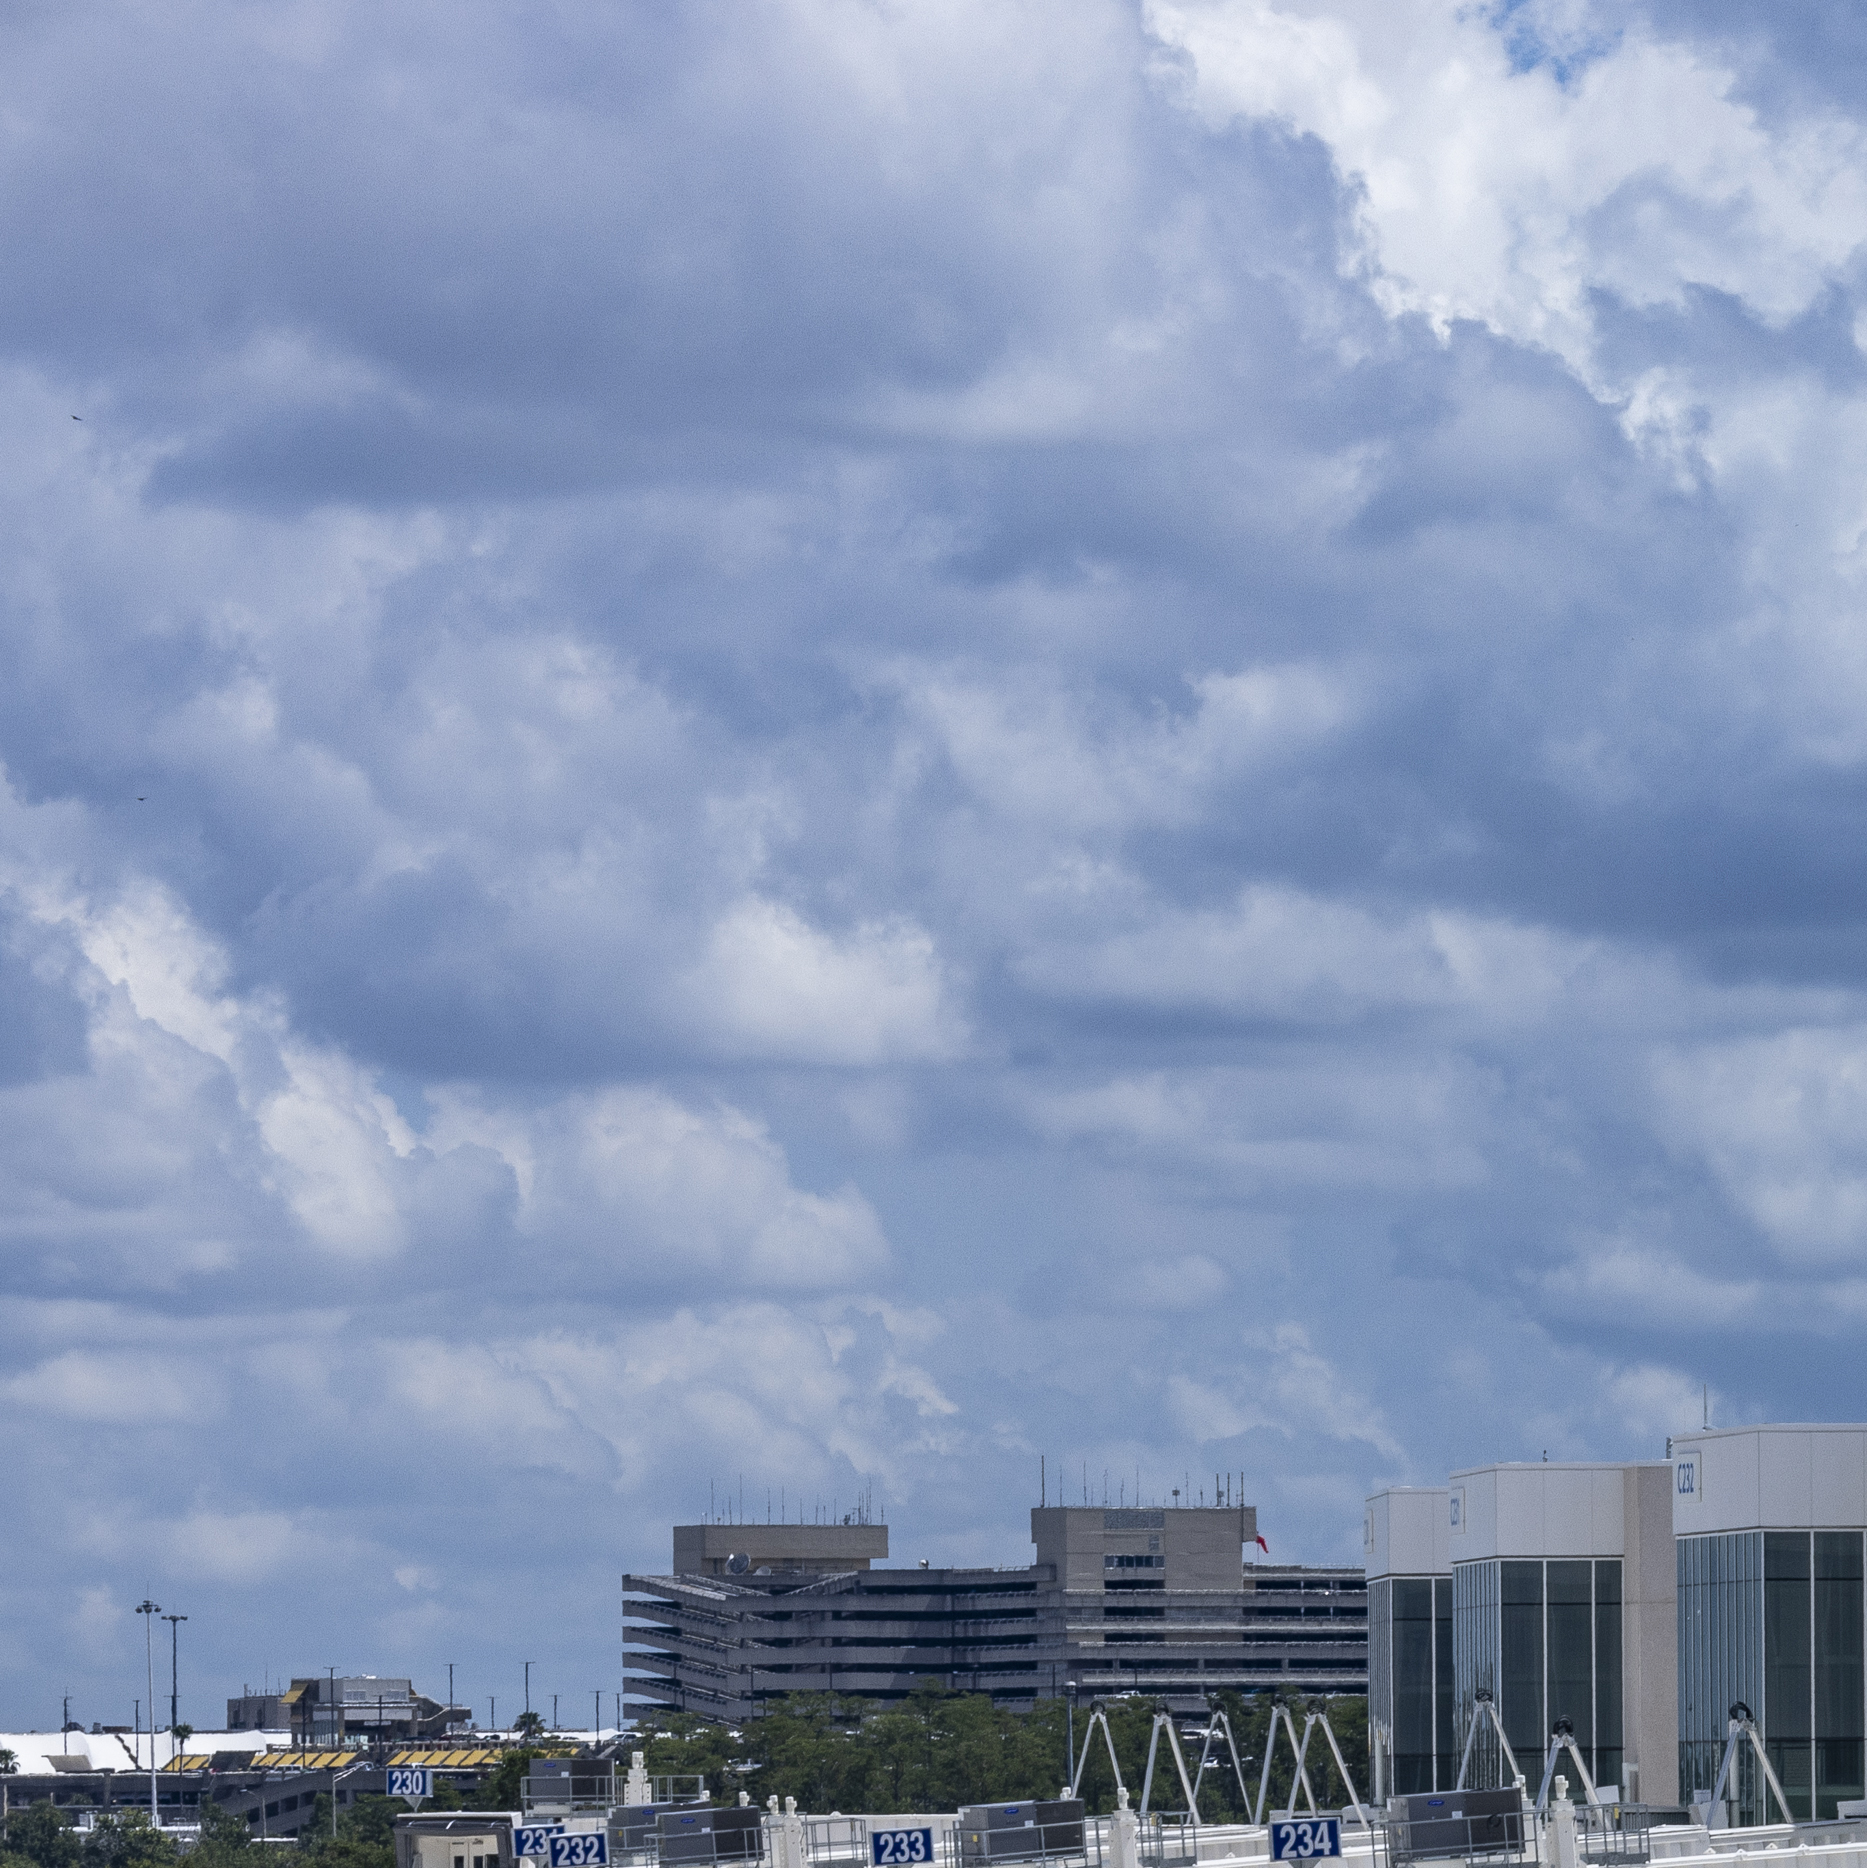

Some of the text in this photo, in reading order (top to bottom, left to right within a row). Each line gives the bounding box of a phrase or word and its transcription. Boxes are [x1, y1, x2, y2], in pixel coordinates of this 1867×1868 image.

[1677, 1462, 1694, 1494] C232
[391, 1769, 422, 1796] 230
[521, 1826, 558, 1855] 23
[555, 1835, 600, 1866] 232
[879, 1830, 926, 1863] 233
[1279, 1821, 1332, 1859] 234
